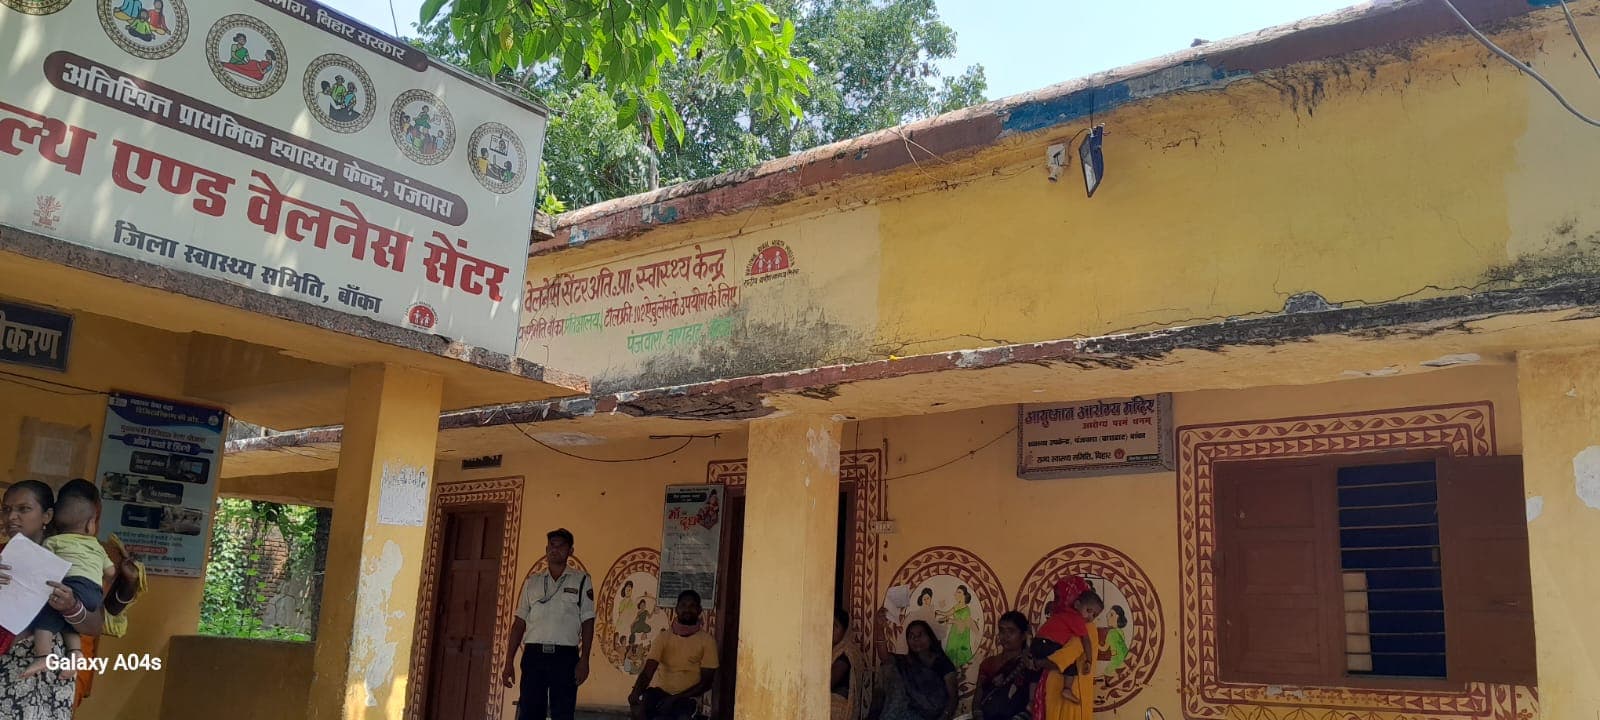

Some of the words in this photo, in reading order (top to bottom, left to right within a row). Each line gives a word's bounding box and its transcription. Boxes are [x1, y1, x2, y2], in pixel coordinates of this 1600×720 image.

[317, 9, 357, 39] बिहार
[358, 30, 406, 61] सरकार
[62, 62, 174, 118] अतिरिक्त
[179, 103, 266, 150] प्राथमिक
[270, 136, 339, 178] स्वास्थ्य
[393, 178, 455, 218] पंजवारा
[0, 103, 97, 176] ल्थ
[111, 139, 236, 217] एण्ड
[247, 169, 414, 273] वेलनेस
[422, 230, 510, 303] सेंटर
[113, 219, 180, 258] जिला
[184, 243, 256, 280] स्वास्थ्य
[261, 265, 331, 304] समिति,
[692, 244, 727, 282] केन्द्र
